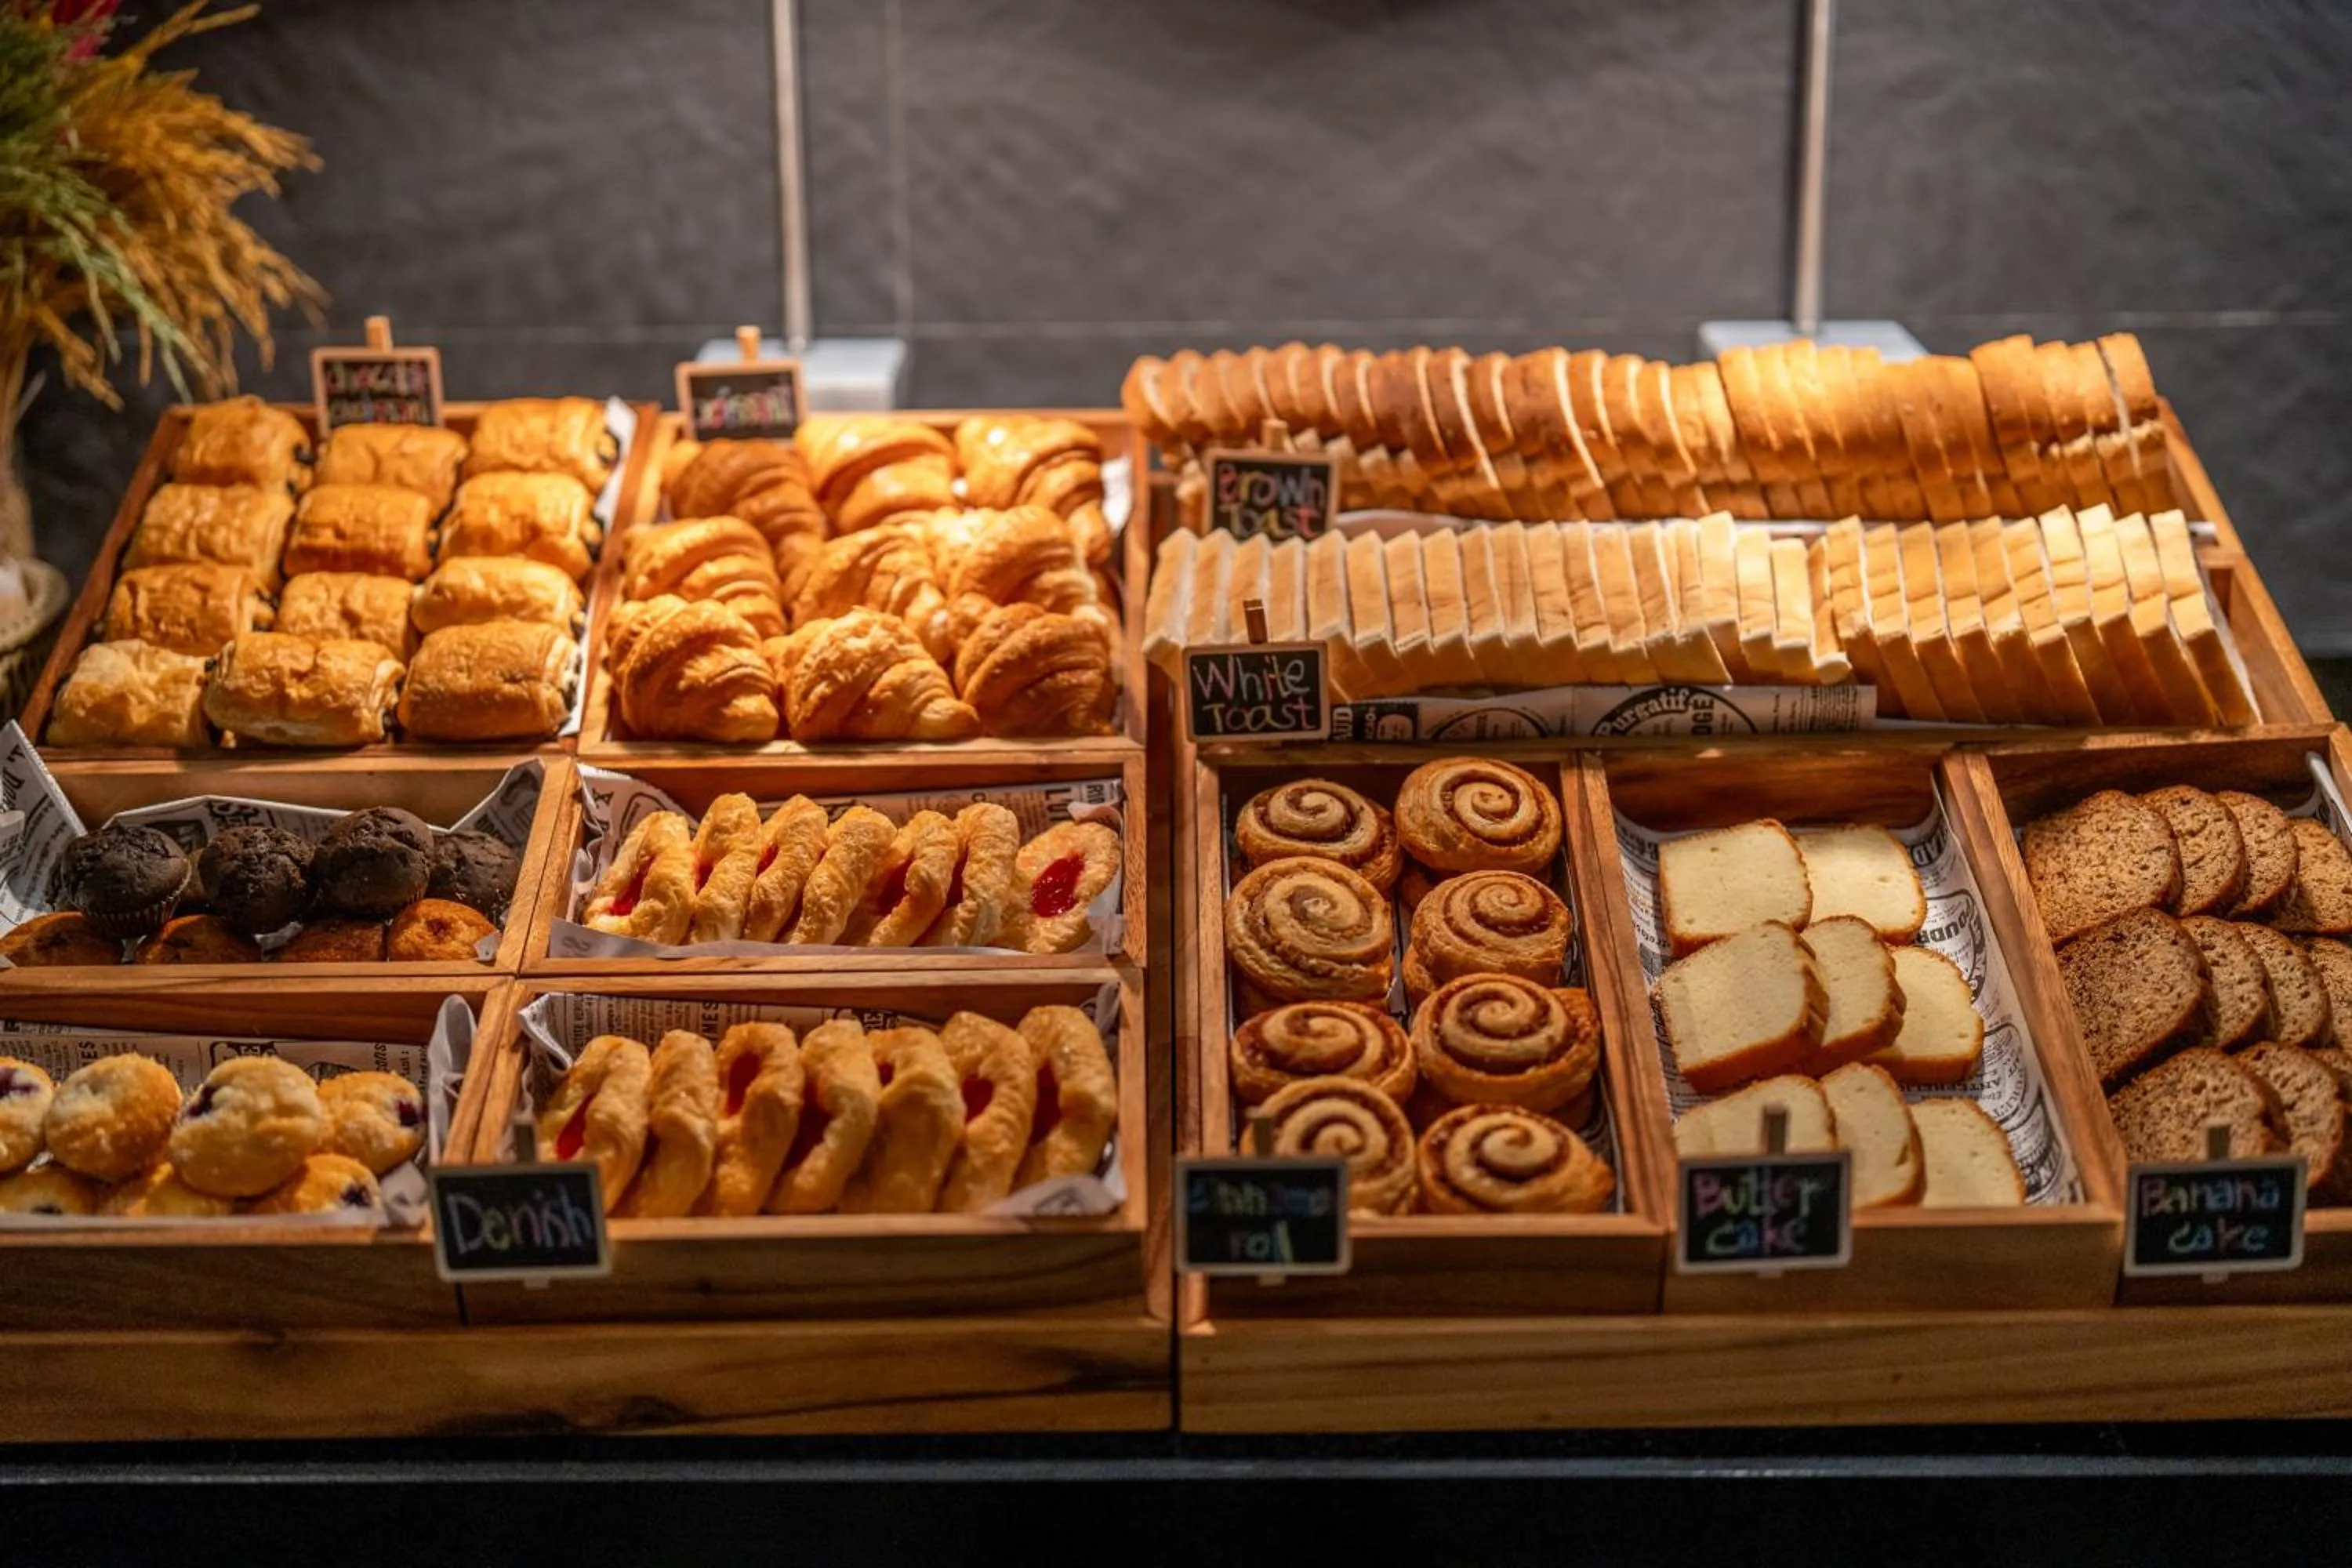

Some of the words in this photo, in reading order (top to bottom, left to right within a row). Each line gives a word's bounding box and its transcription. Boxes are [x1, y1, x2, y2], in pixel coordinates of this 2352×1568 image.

[1192, 654, 1311, 702] White
[1201, 695, 1317, 734] Toast
[2140, 1178, 2280, 1216] Banana
